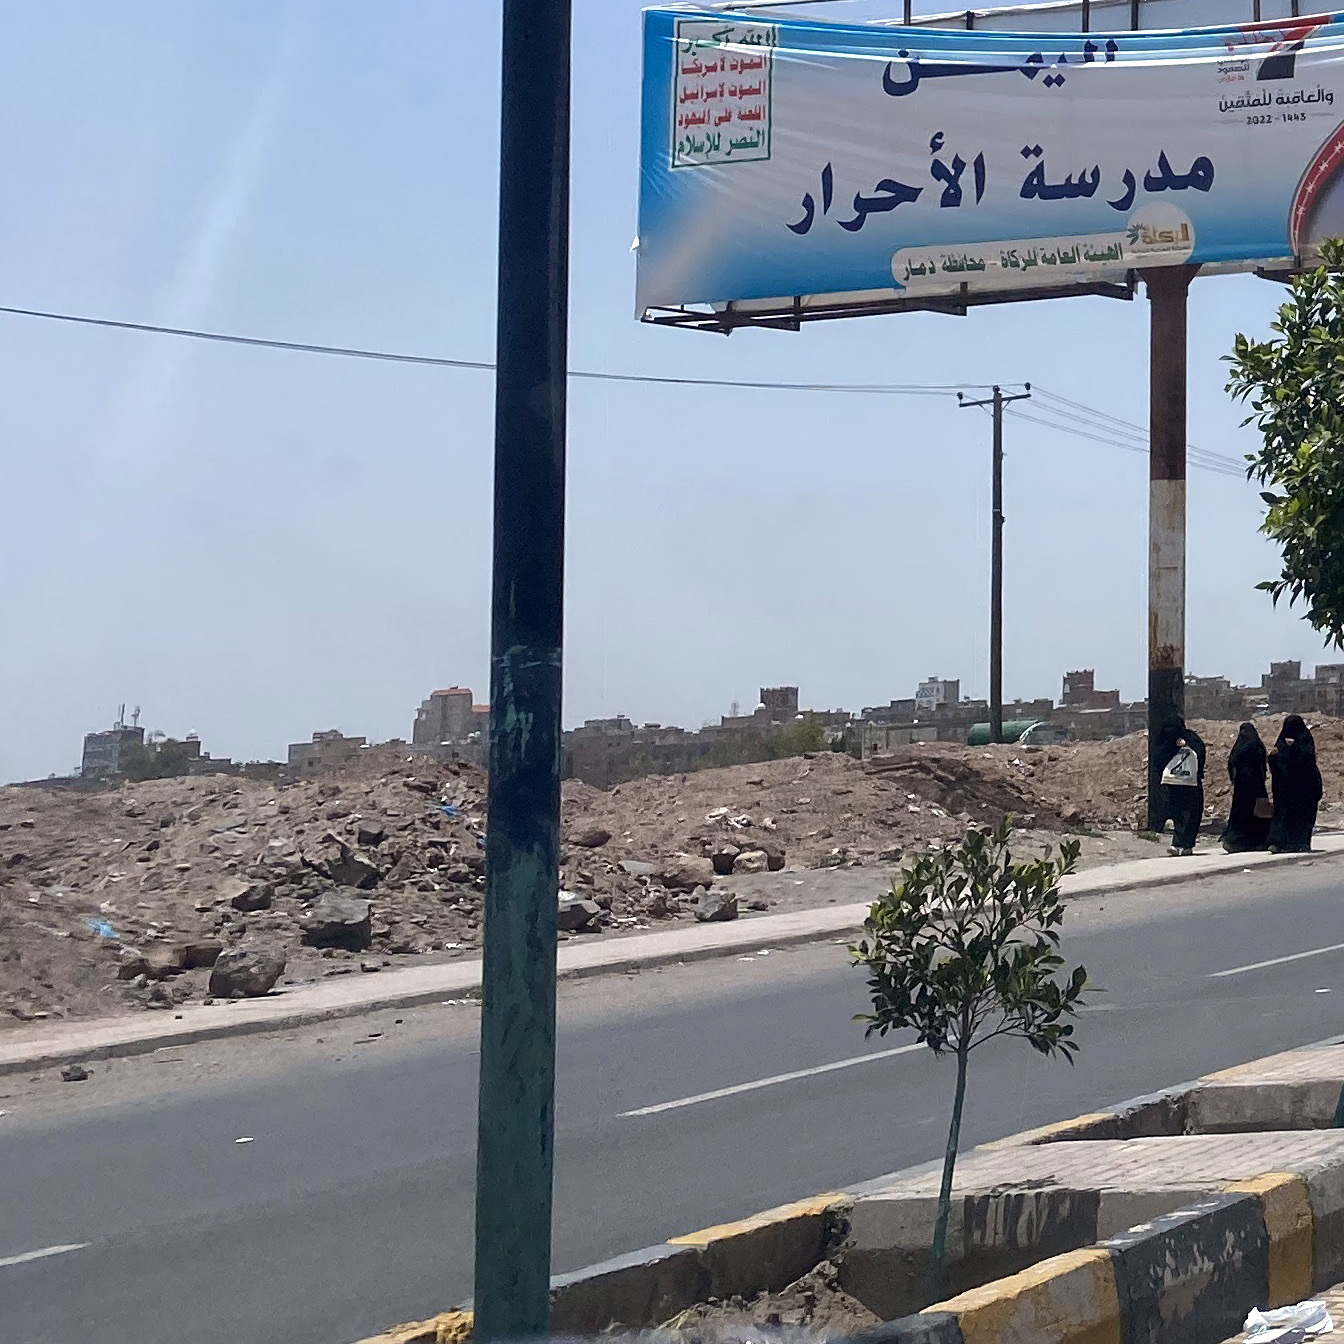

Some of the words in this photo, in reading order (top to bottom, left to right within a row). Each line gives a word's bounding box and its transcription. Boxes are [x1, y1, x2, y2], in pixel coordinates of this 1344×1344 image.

[729, 53, 768, 75] الموت
[727, 79, 767, 101] الموت
[1246, 115, 1273, 126] 2022
[1281, 112, 1307, 123] 1443
[724, 126, 766, 157] النصر
[784, 130, 987, 236] الأحرار
[1019, 143, 1216, 213] مدرسة
[1039, 245, 1082, 267] العامة
